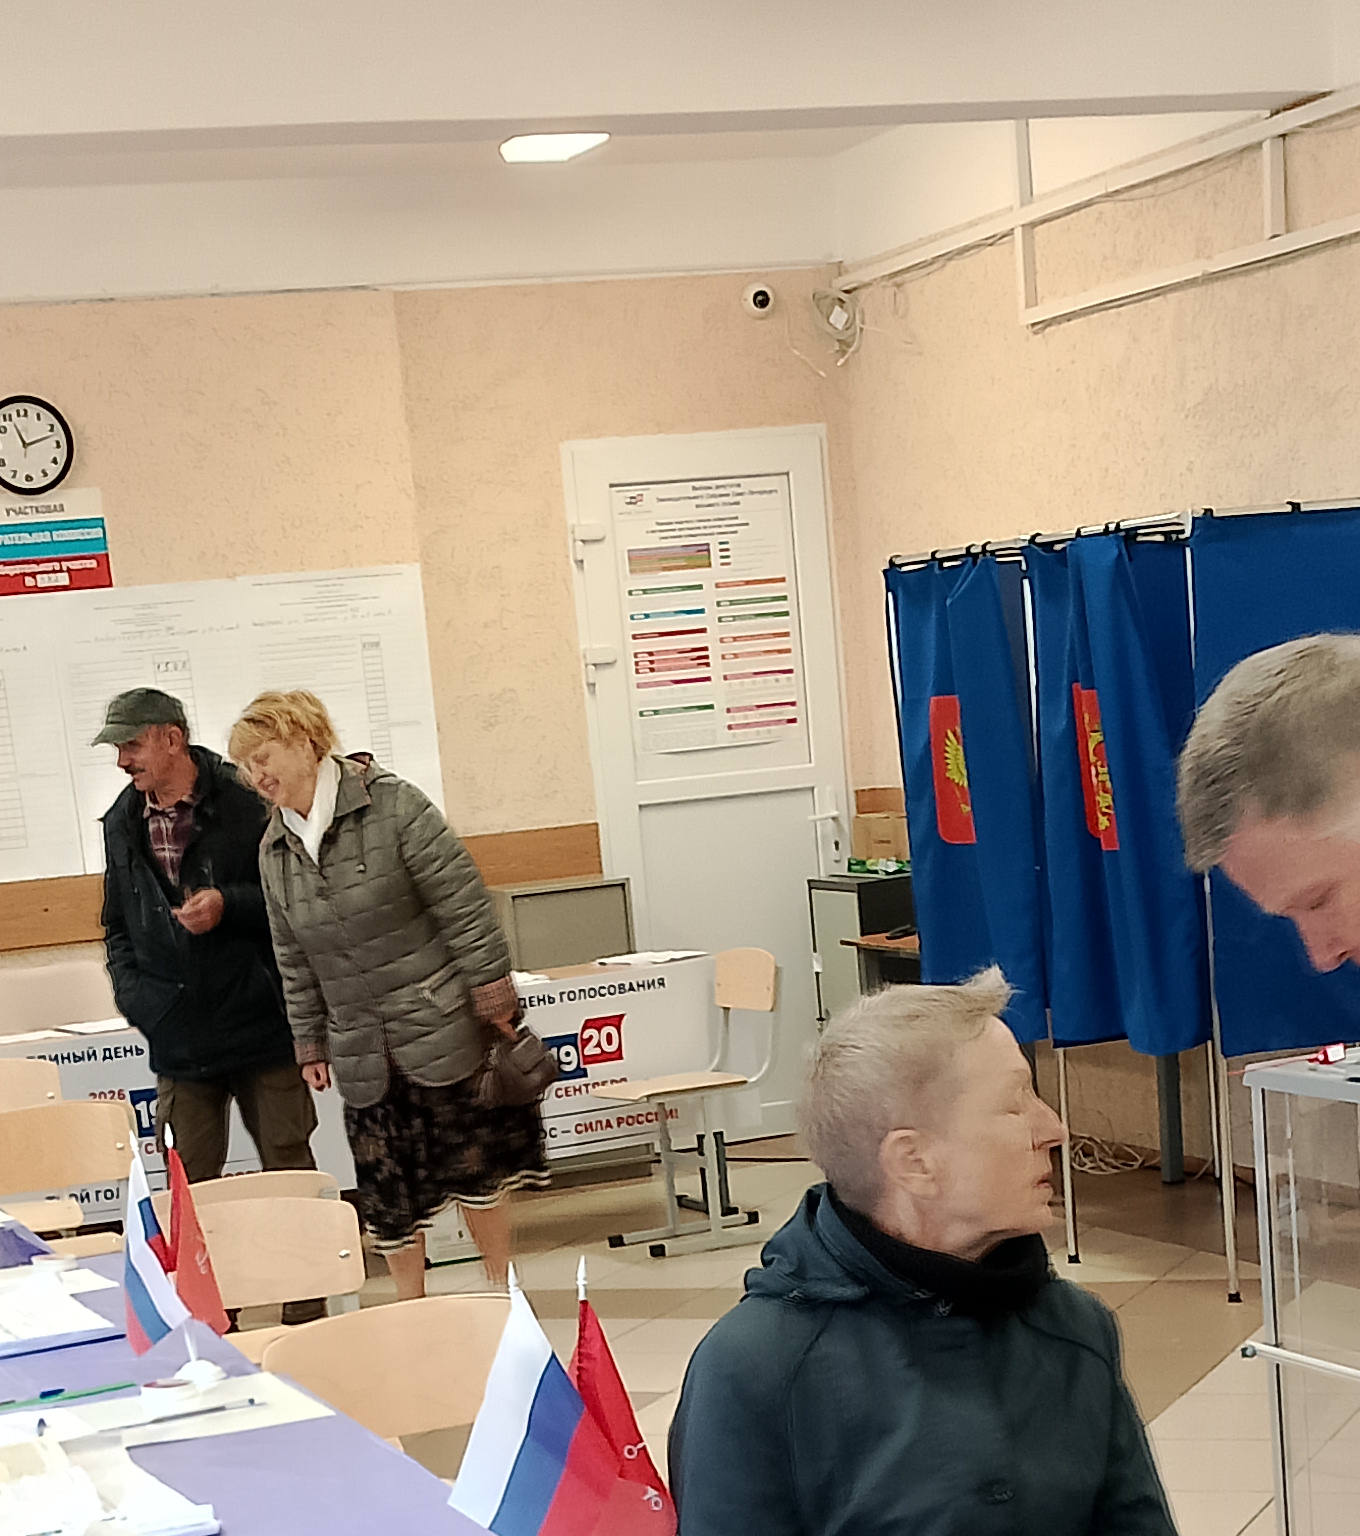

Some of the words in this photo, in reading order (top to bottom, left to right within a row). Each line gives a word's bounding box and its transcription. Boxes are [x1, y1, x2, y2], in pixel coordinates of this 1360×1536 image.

[559, 976, 666, 1003] ГОЛОСОВАНИЯ
[582, 1026, 619, 1055] 20
[102, 1045, 145, 1062] ДЕНЬ
[574, 1118, 613, 1135] СИЛА
